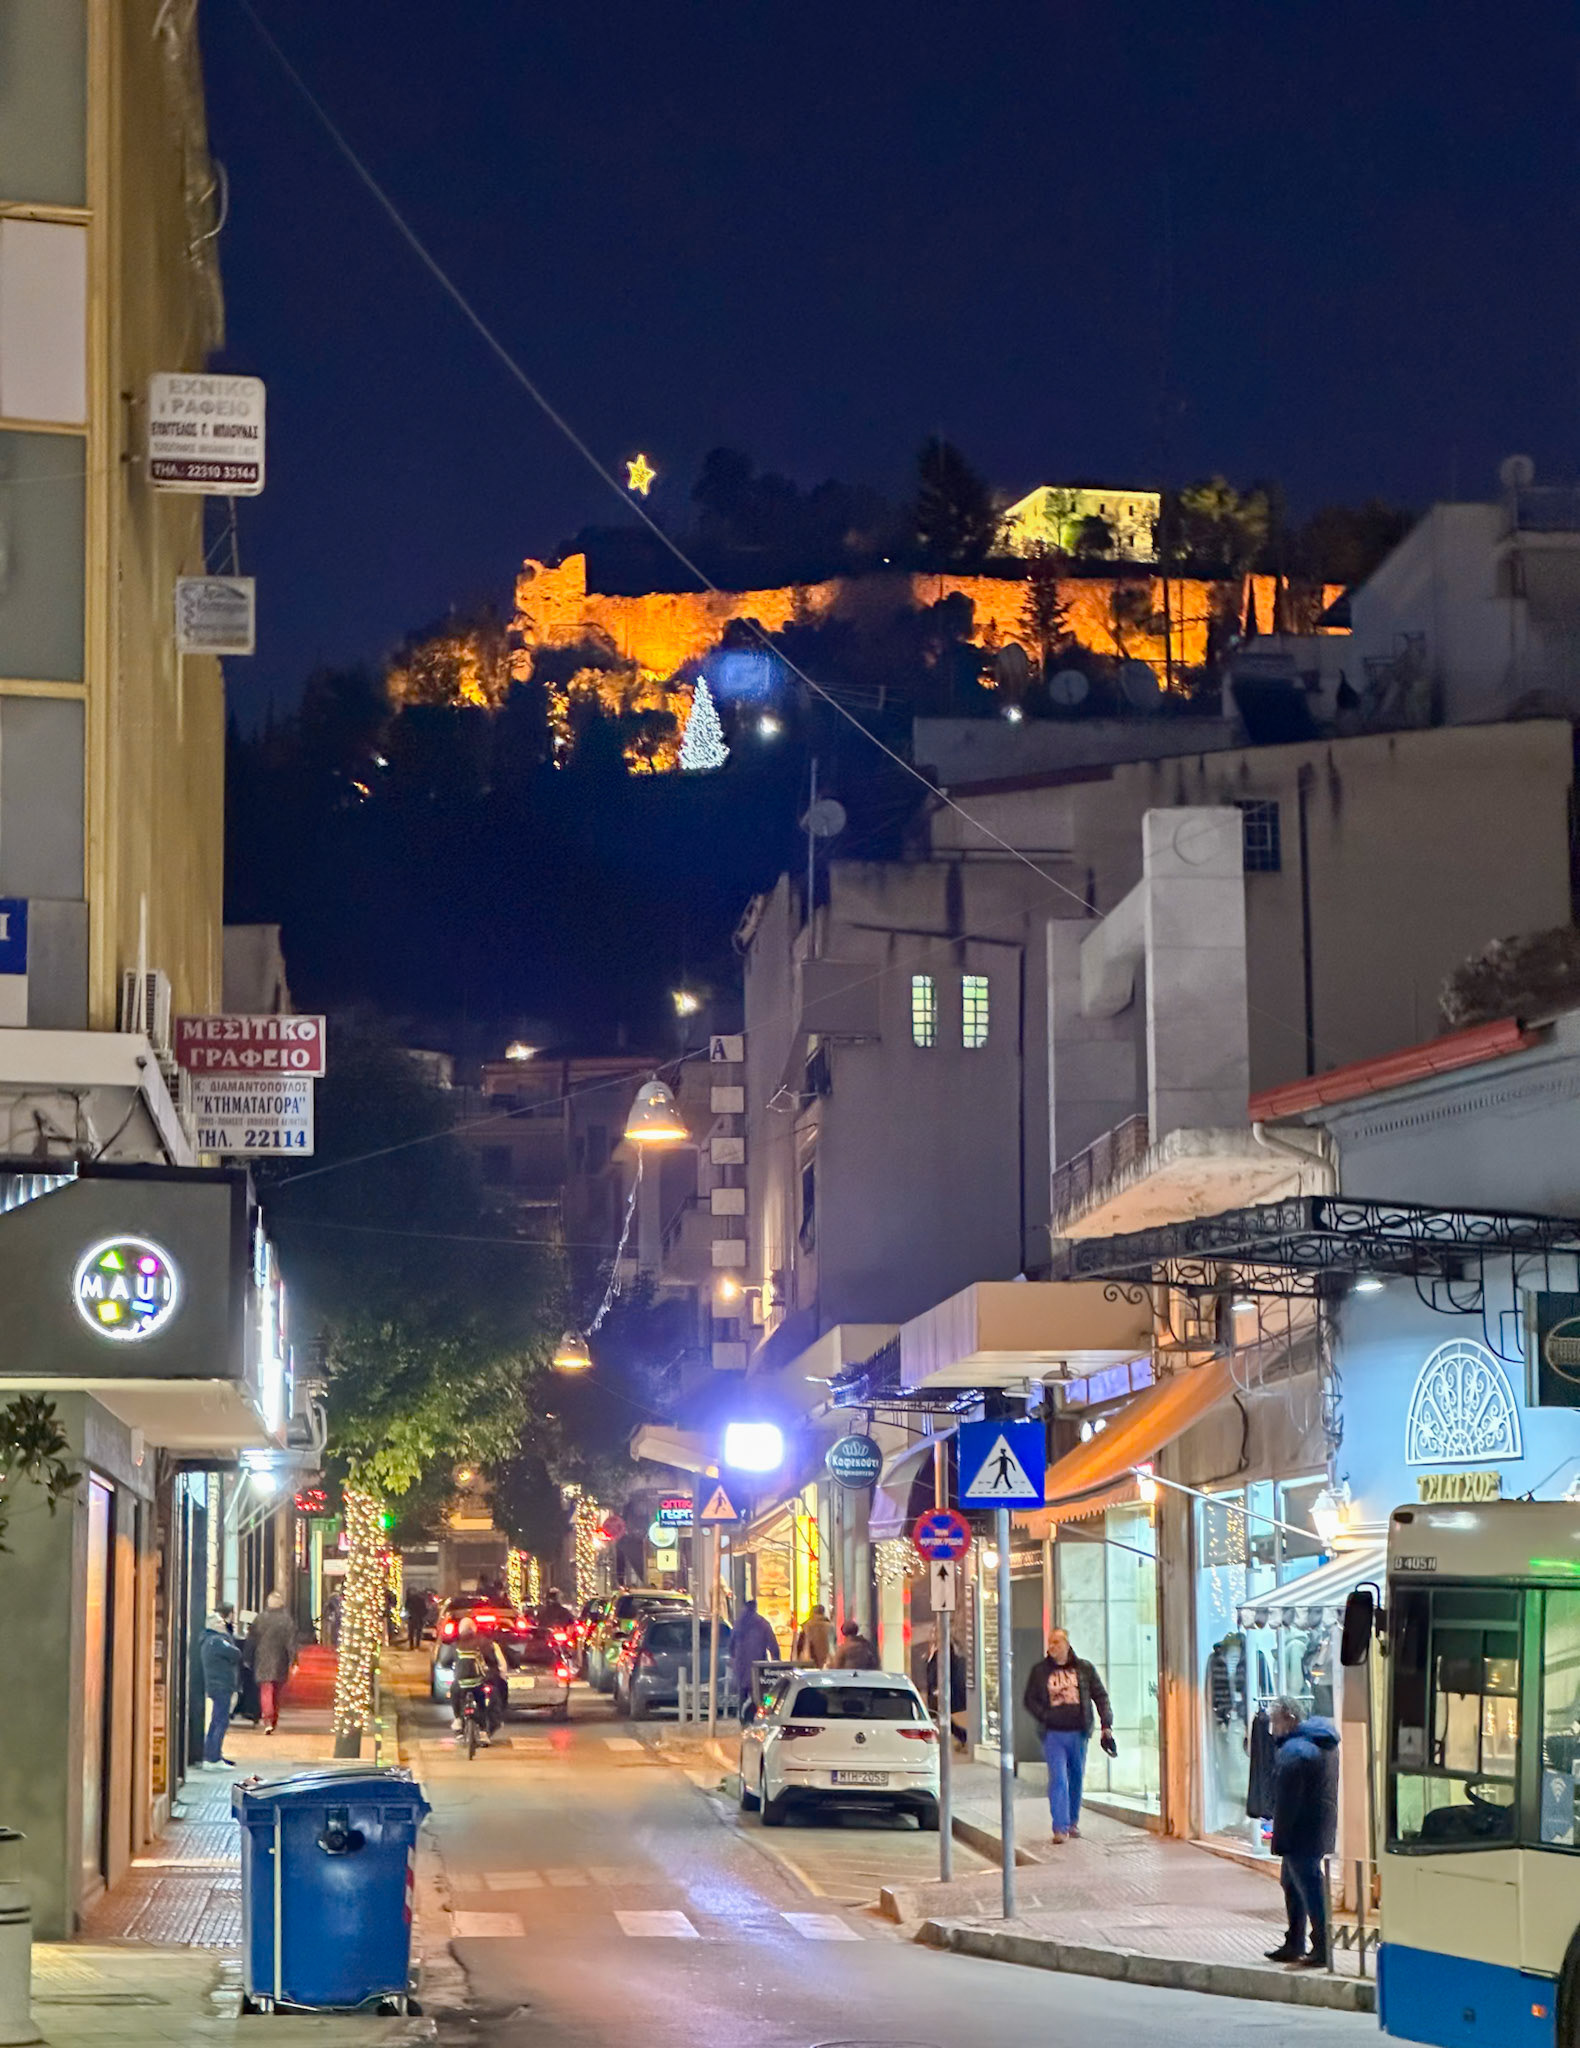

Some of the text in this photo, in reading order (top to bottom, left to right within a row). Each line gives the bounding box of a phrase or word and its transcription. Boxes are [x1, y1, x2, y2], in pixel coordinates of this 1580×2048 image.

[182, 1019, 317, 1041] ΜΕΣΙΤΙΚΟ
[190, 1048, 311, 1068] ΓΡΑΦΕΙΟ
[210, 1080, 308, 1093] ΔΙΑΜΑΝΤΟΠΟΥΛΟΣ
[196, 1096, 306, 1114] "ΚΤΗΜΑΤΑΓΟΡΑ"
[244, 1130, 307, 1147] 22114
[80, 1275, 171, 1300] MAUI
